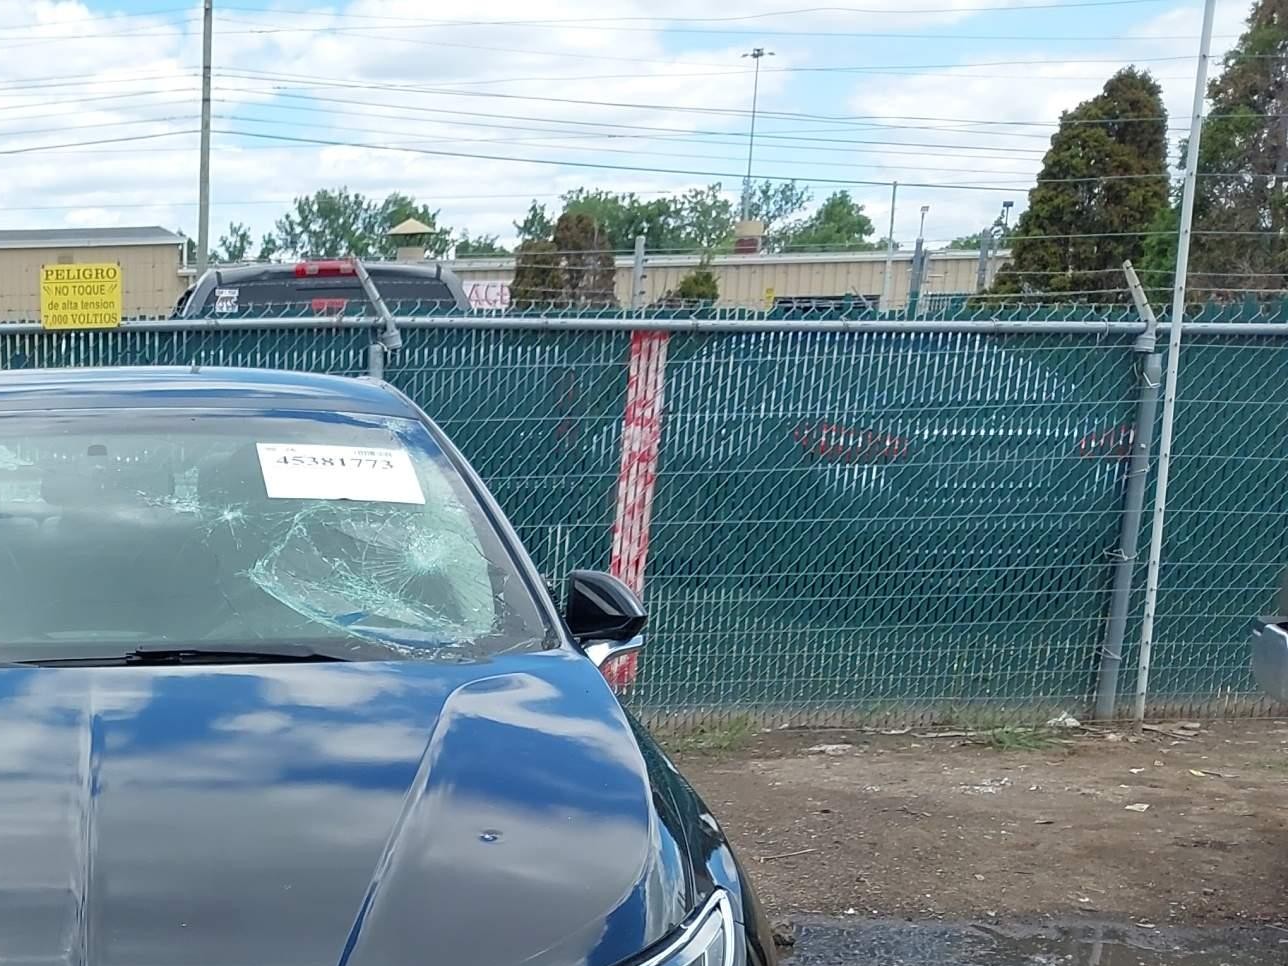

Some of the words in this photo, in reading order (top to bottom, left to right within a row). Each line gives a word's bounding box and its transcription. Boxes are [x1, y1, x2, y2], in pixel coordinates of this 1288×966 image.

[45, 267, 118, 281] PELIGRO
[54, 285, 69, 297] NO
[72, 284, 106, 296] TOQUE
[47, 300, 59, 311] de
[62, 299, 78, 311] alta
[71, 312, 118, 325] VOLTIOS
[275, 455, 394, 470] 45381773
